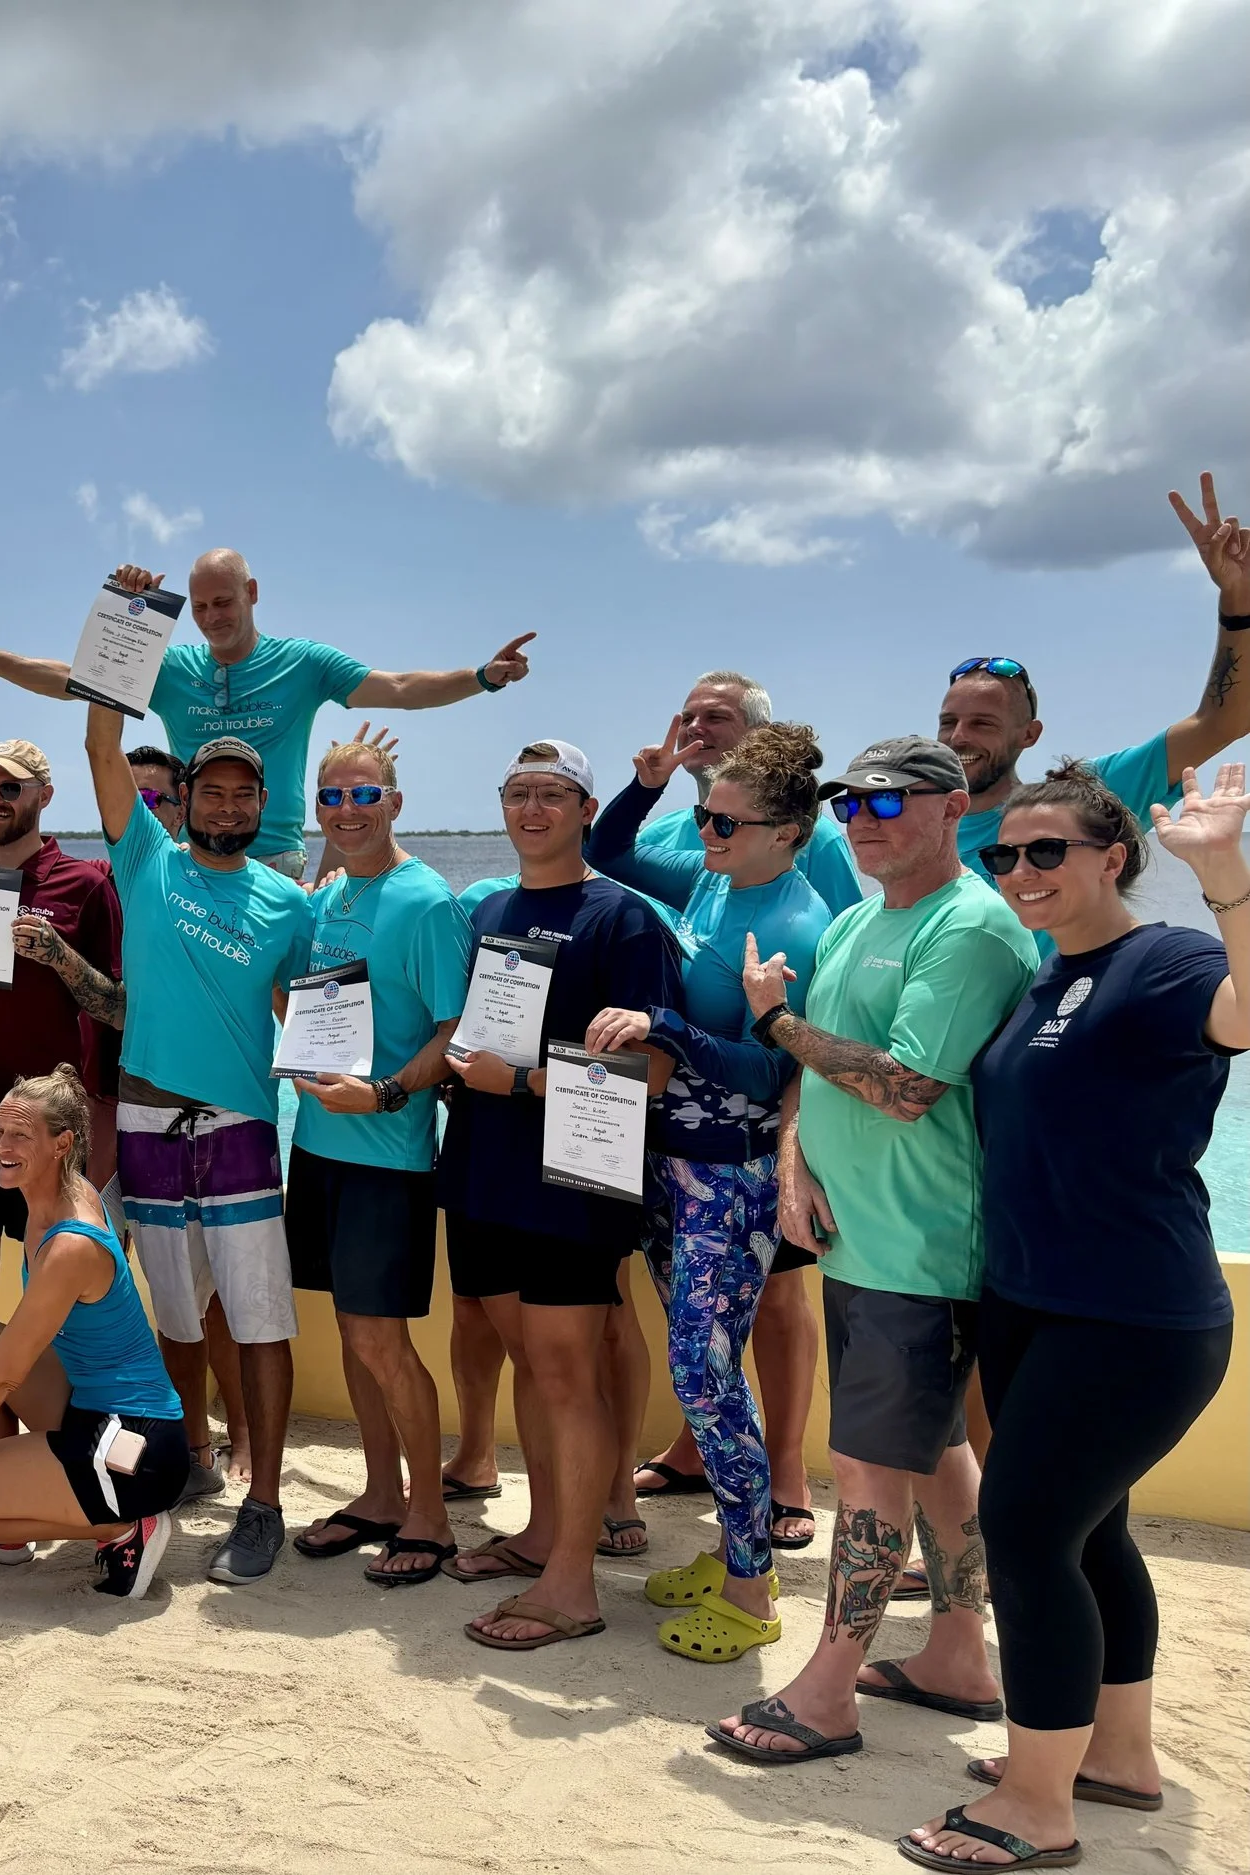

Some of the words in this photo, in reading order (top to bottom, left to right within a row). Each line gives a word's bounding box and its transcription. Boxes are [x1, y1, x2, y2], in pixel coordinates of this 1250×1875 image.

[97, 611, 124, 625] CERTIFICATE
[132, 623, 163, 638] COMPLETION
[195, 719, 223, 732] ...not
[225, 716, 274, 730] troubles
[864, 749, 890, 759] PADI
[31, 907, 54, 916] scuba
[168, 892, 207, 918] make
[200, 929, 251, 966] troubles
[479, 973, 503, 983] CERTIFICATE
[509, 979, 540, 990] COMPLETION
[295, 1007, 325, 1016] CERTIFICATE
[334, 1000, 365, 1010] COMPLETION
[1037, 1018, 1071, 1034] PADI
[553, 1046, 566, 1054] PADI
[555, 1086, 589, 1098] CERTIFICATE
[600, 1094, 637, 1106] COMPLETION
[548, 1174, 574, 1184] INSTRUCTOR
[575, 1180, 606, 1191] DEVELOPMENT
